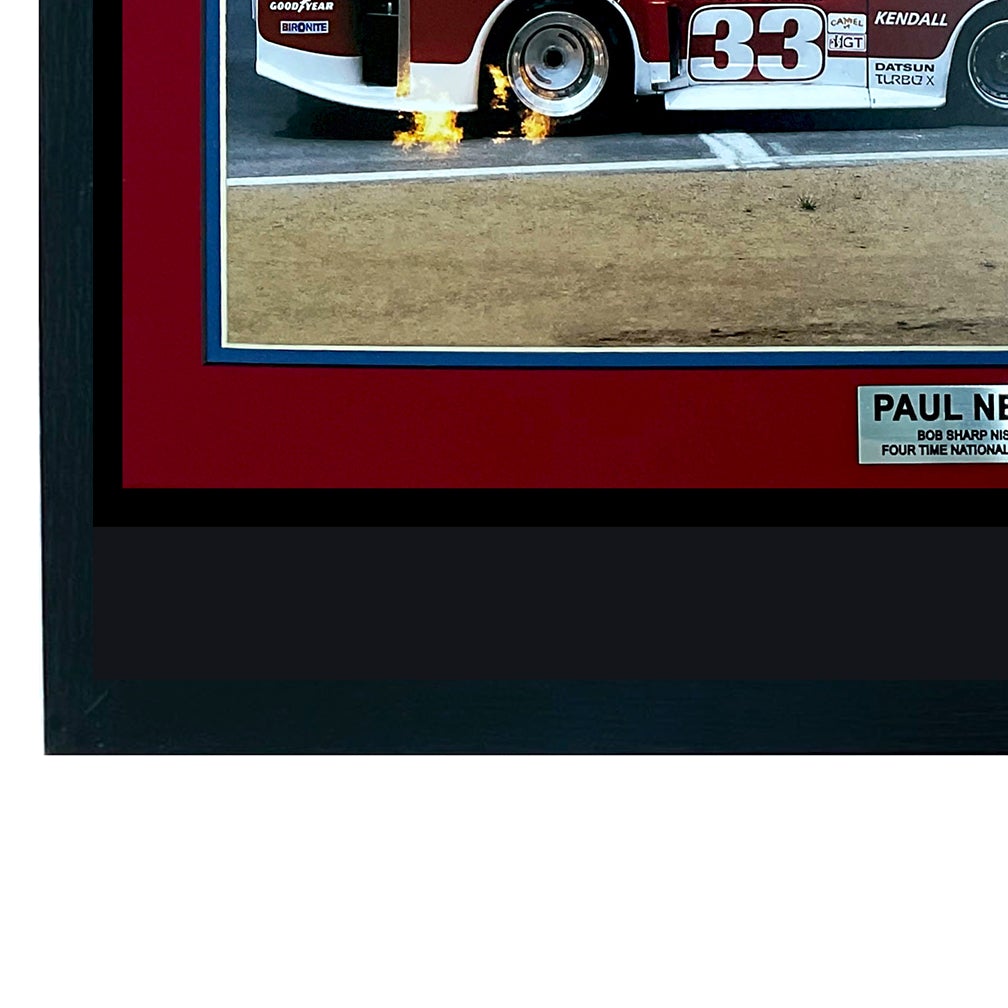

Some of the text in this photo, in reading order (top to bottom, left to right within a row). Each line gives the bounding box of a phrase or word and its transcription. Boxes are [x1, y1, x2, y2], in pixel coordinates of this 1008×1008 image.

[269, 0, 334, 13] GOODYEAR
[831, 17, 863, 27] CAMEL
[874, 11, 948, 26] KENDALL
[282, 22, 327, 33] BIRONITE
[690, 8, 823, 81] 33
[875, 63, 934, 72] DATSUN
[875, 74, 935, 86] TURBO X
[874, 393, 962, 421] PAUL
[918, 429, 942, 441] BOB
[946, 429, 987, 441] SHARP
[882, 445, 916, 456] FOUR
[919, 445, 948, 456] TIME
